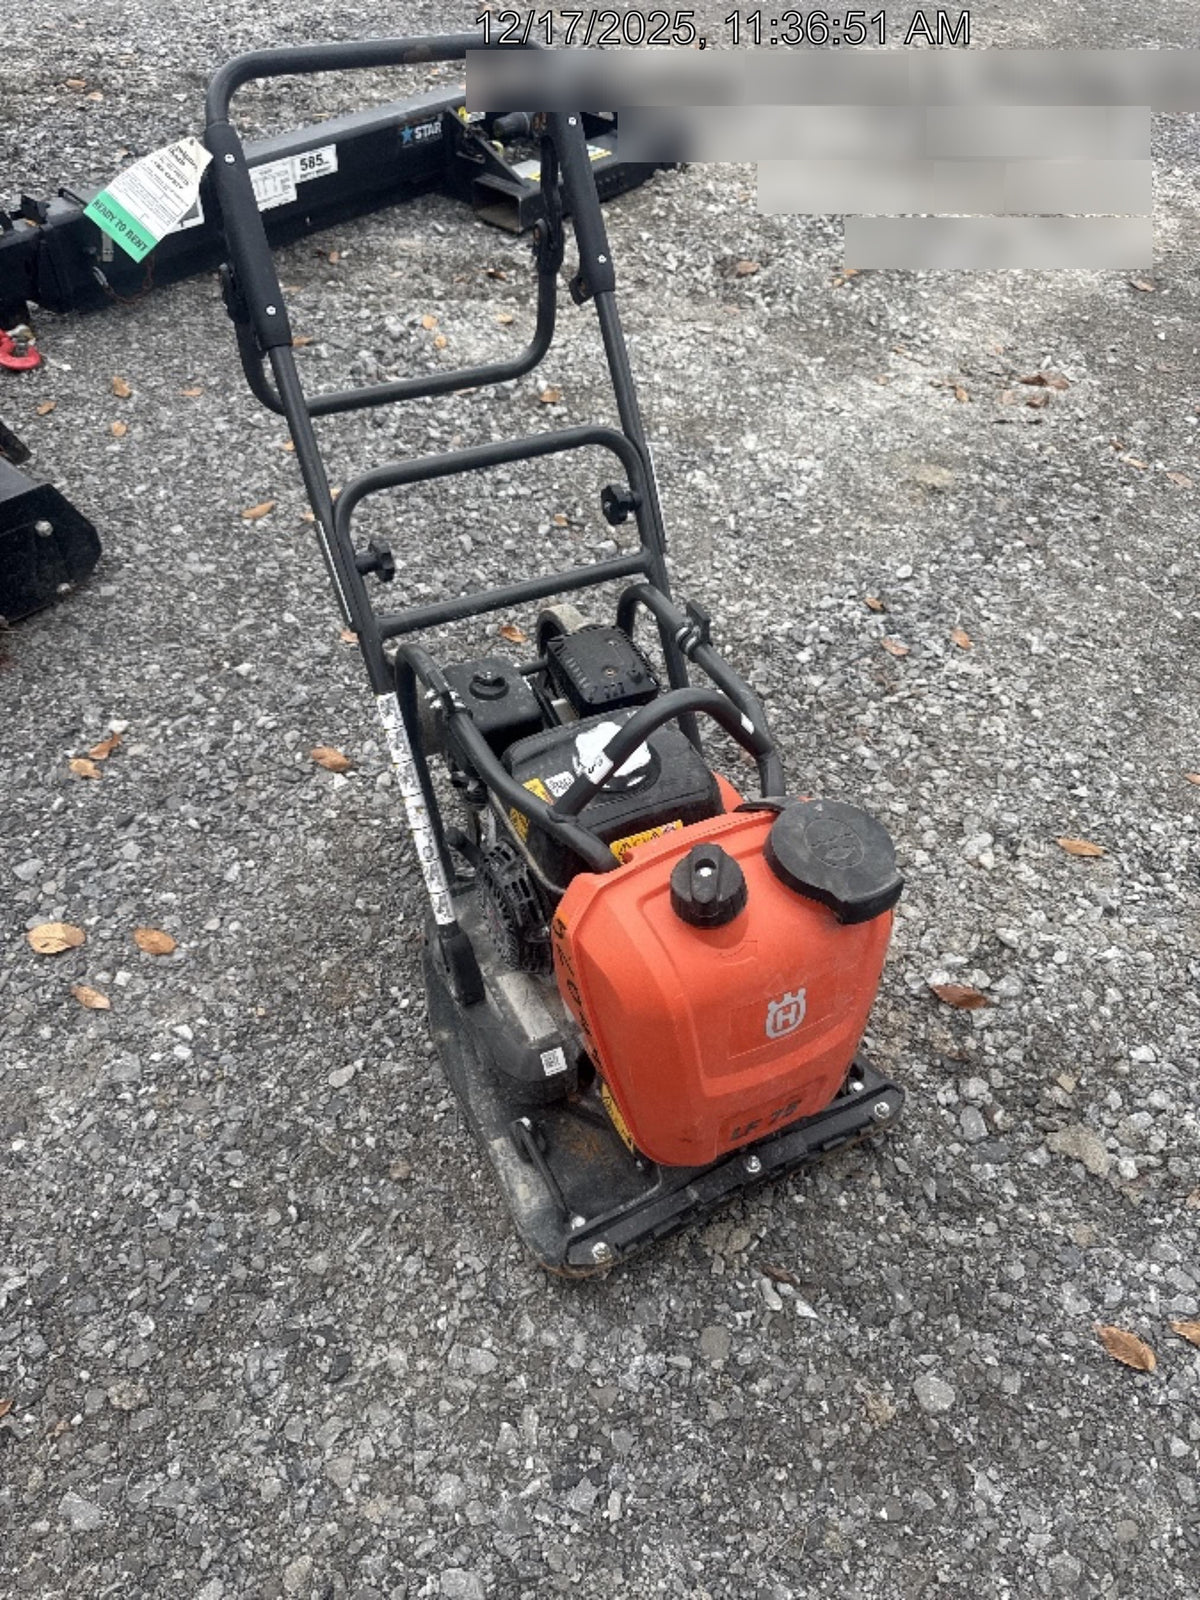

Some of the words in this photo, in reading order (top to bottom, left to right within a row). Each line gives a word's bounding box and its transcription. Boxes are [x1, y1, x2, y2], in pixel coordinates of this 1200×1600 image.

[415, 121, 442, 139] STAR
[300, 153, 324, 171] 585
[92, 199, 117, 221] READY
[115, 219, 127, 232] TO
[125, 229, 148, 251] RENT
[731, 1118, 763, 1141] LF
